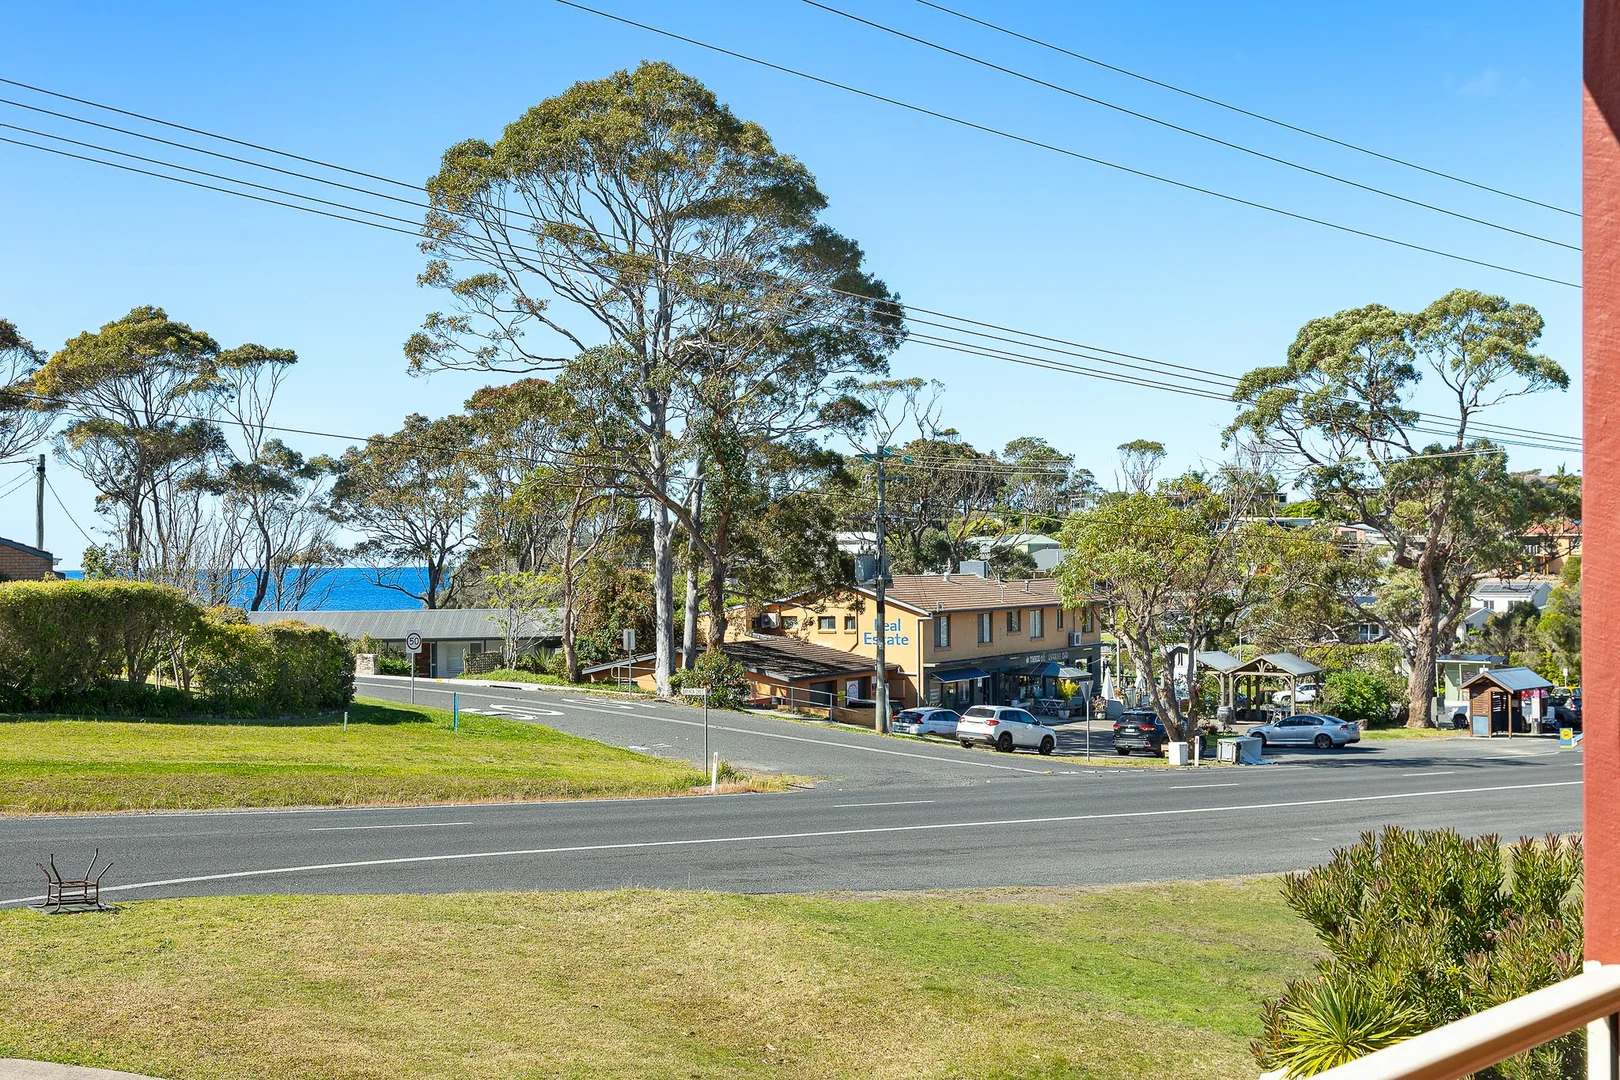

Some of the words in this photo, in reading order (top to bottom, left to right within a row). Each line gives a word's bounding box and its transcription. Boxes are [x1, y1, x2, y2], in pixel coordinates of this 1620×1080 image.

[874, 618, 901, 631] eal
[409, 637, 420, 646] 50
[863, 632, 909, 645] Esate
